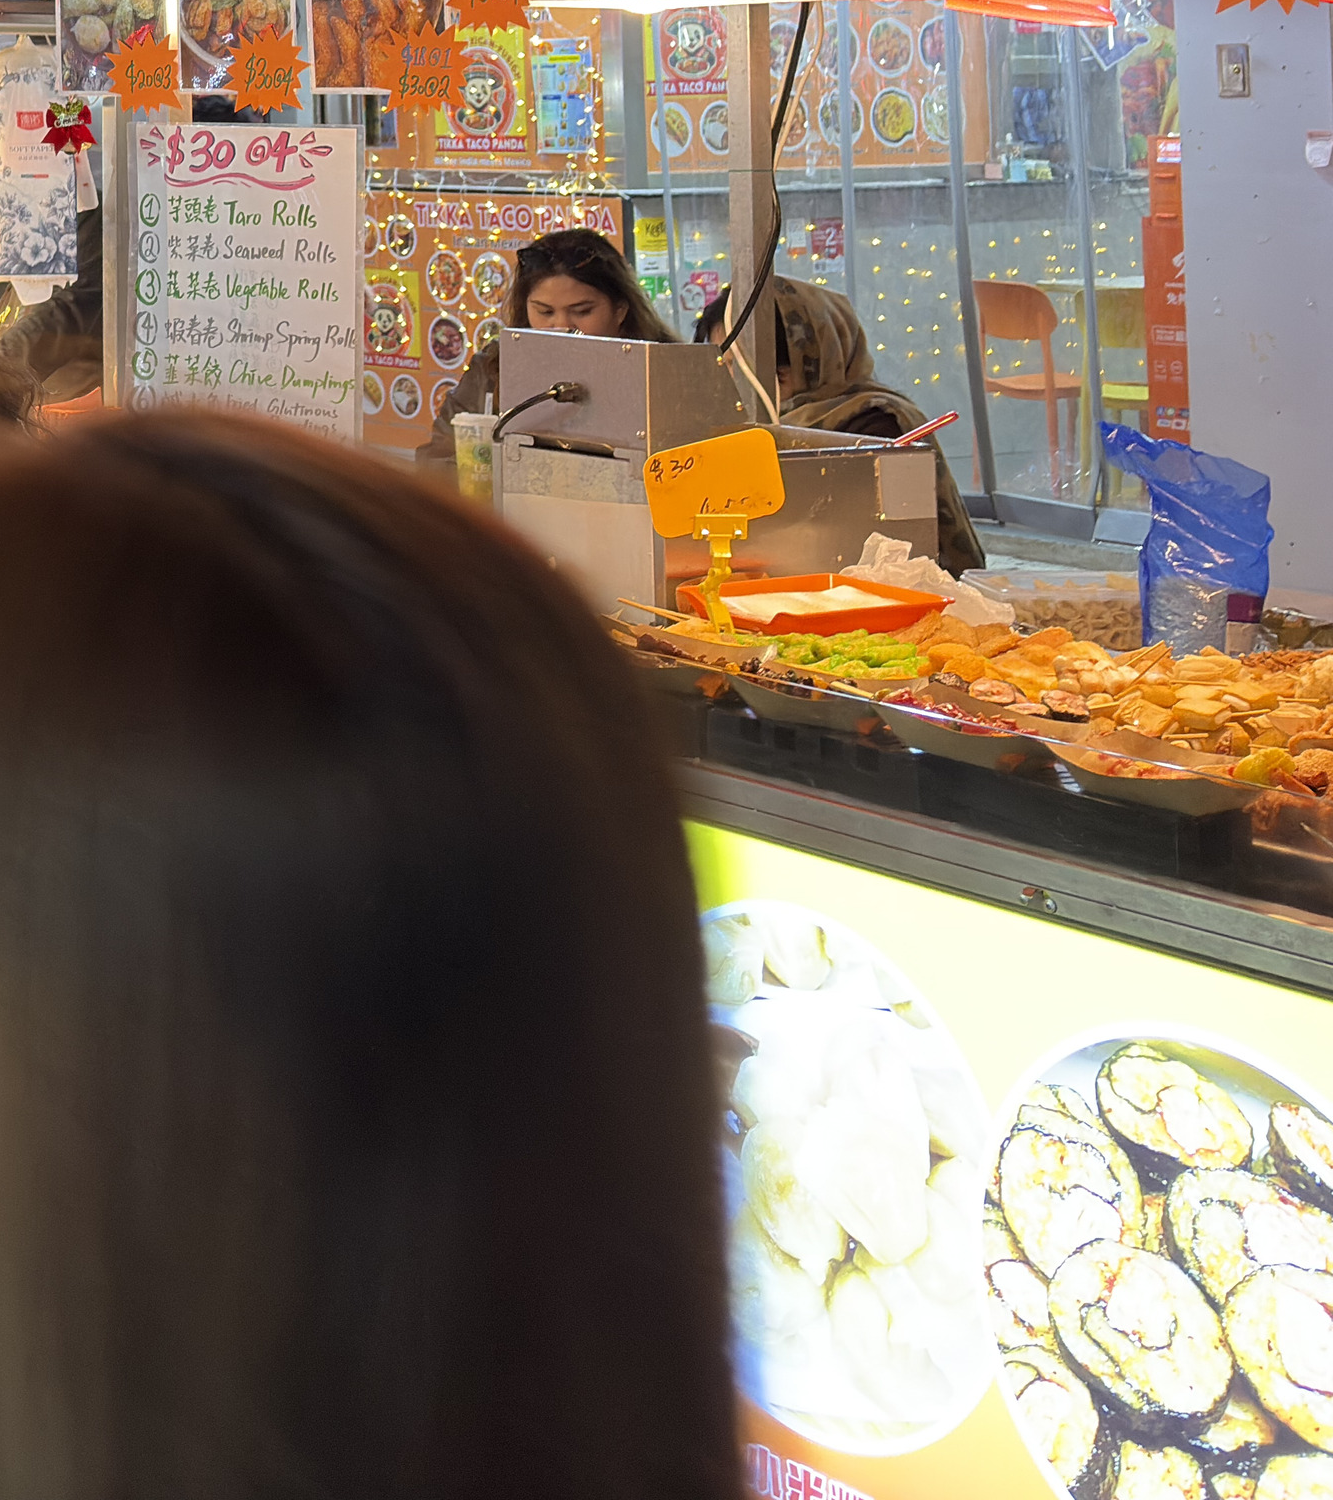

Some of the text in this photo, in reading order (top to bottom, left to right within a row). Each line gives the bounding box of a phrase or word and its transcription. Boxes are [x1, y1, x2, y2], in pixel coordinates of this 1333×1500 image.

[679, 81, 704, 93] TACO
[166, 126, 298, 174] $30 @4
[438, 138, 524, 150] TIKKA TACO PANDA
[224, 200, 262, 227] Taro
[272, 200, 318, 228] Rolls
[415, 202, 473, 229] TIKKA
[476, 203, 532, 232] TACO
[223, 235, 285, 260] Seaweed
[295, 239, 337, 264] Rolls
[226, 274, 291, 310] Vegetable
[297, 279, 339, 301] Rolls
[226, 318, 273, 352] Shrimp
[276, 321, 320, 362] Spring
[229, 359, 276, 385] Chive
[280, 366, 356, 404] Dumplings
[266, 397, 339, 419] Glutinous
